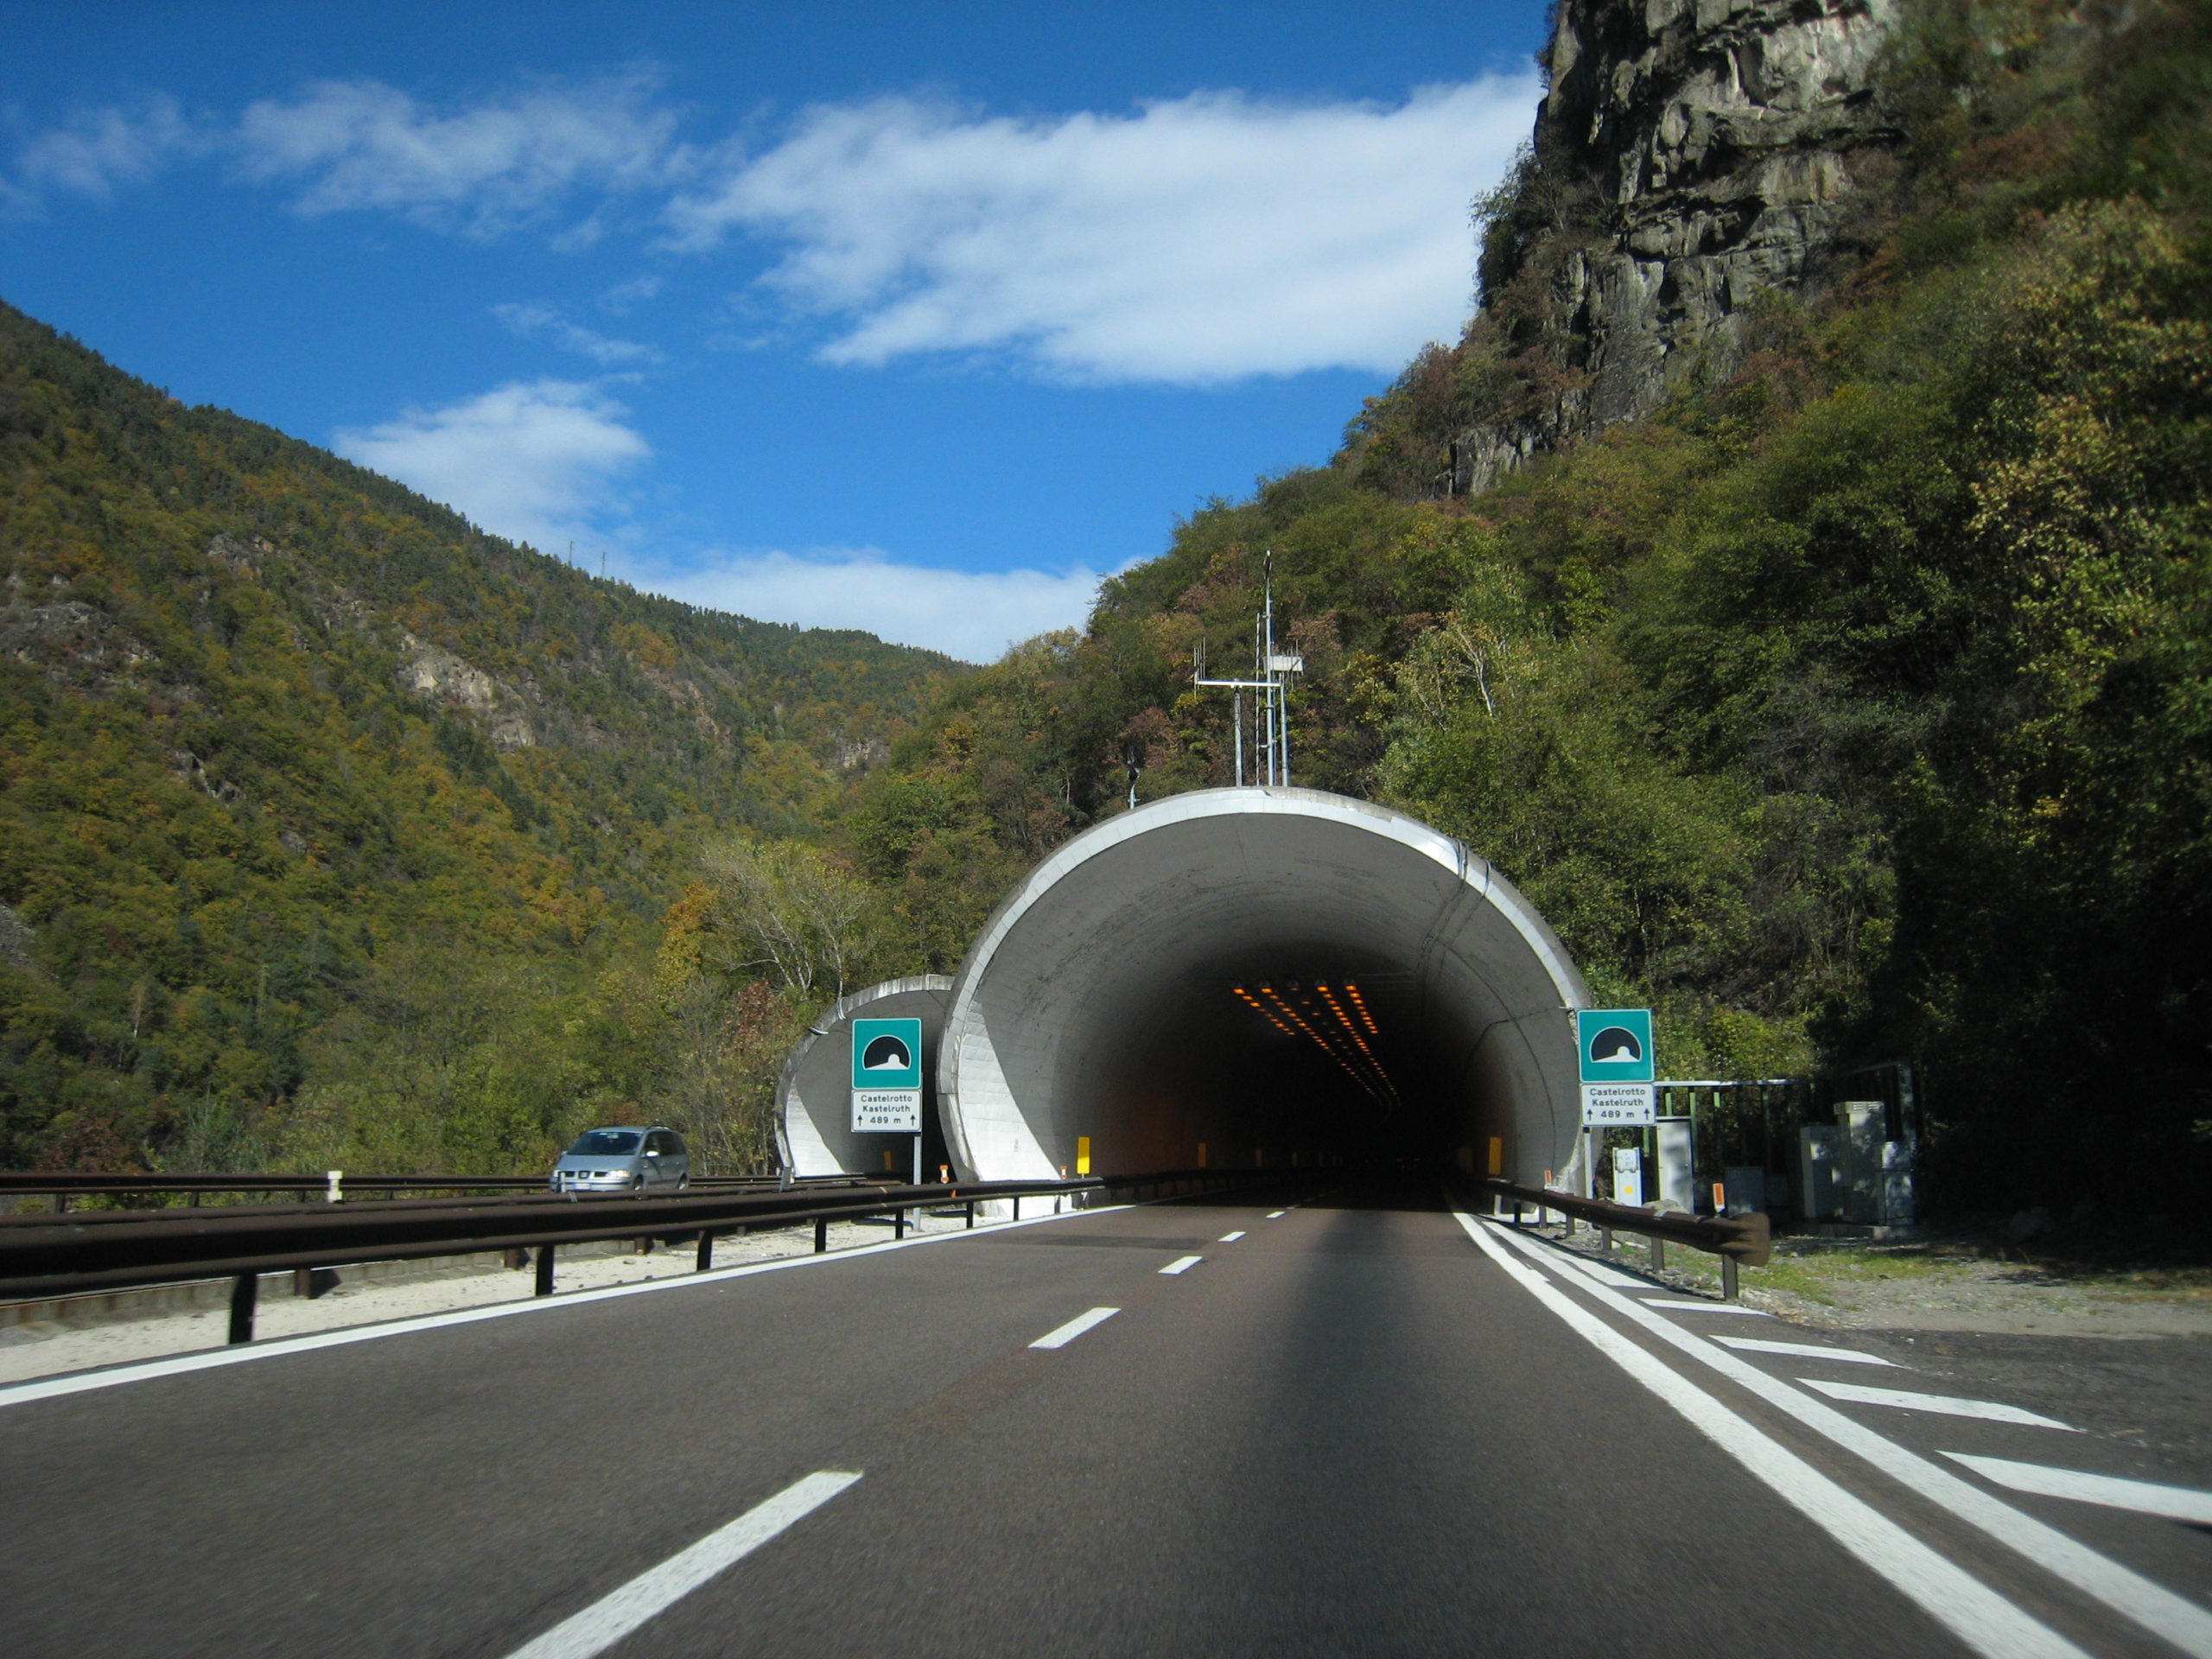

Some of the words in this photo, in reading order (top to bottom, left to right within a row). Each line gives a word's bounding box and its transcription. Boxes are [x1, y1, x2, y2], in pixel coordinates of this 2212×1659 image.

[1589, 1088, 1646, 1096] Castelrotto
[861, 1094, 912, 1103] Castelrotto
[1592, 1098, 1644, 1107] Kastelruth
[870, 1116, 889, 1124] 489
